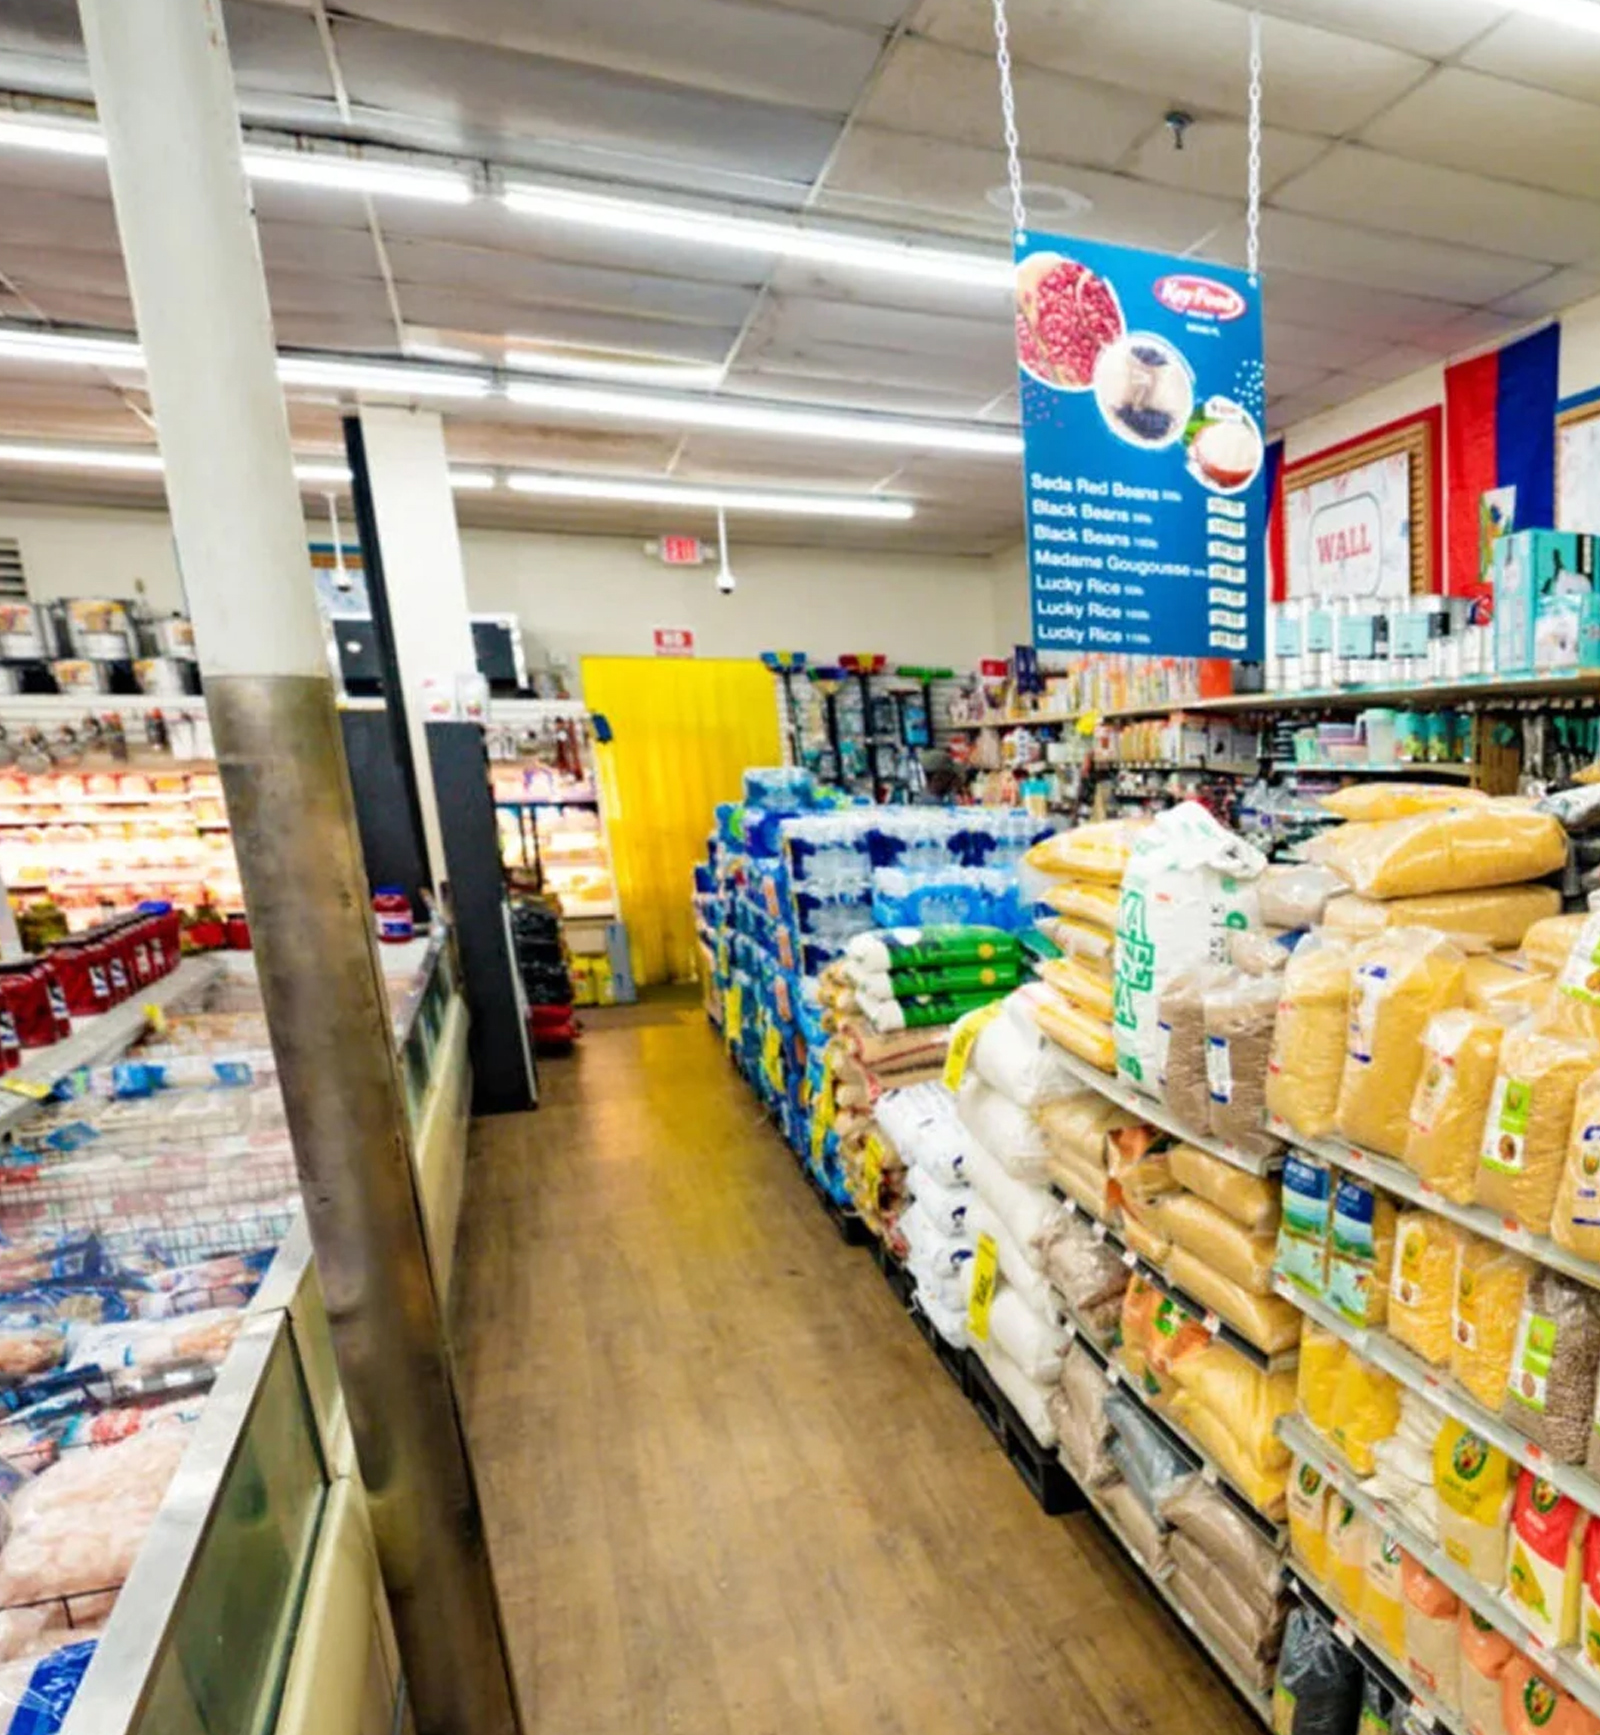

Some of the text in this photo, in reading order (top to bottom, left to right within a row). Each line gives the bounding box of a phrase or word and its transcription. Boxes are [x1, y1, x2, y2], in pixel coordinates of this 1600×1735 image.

[1031, 472, 1072, 492] Seda
[1076, 478, 1108, 496] Red
[1112, 482, 1159, 501] Beans
[1032, 498, 1076, 518] Black
[1081, 503, 1129, 523] Beans
[1033, 524, 1078, 543] Black
[1082, 528, 1130, 547] Beans
[1315, 522, 1372, 563] WALL
[1034, 549, 1103, 569] Madame
[1107, 555, 1191, 577] Gougousse
[1036, 575, 1083, 596] Lucky
[1087, 578, 1121, 595] Rice
[1037, 600, 1084, 620] Lucky
[1088, 602, 1121, 619] Rice
[1038, 624, 1085, 645] Lucky
[1089, 627, 1122, 643] Rice
